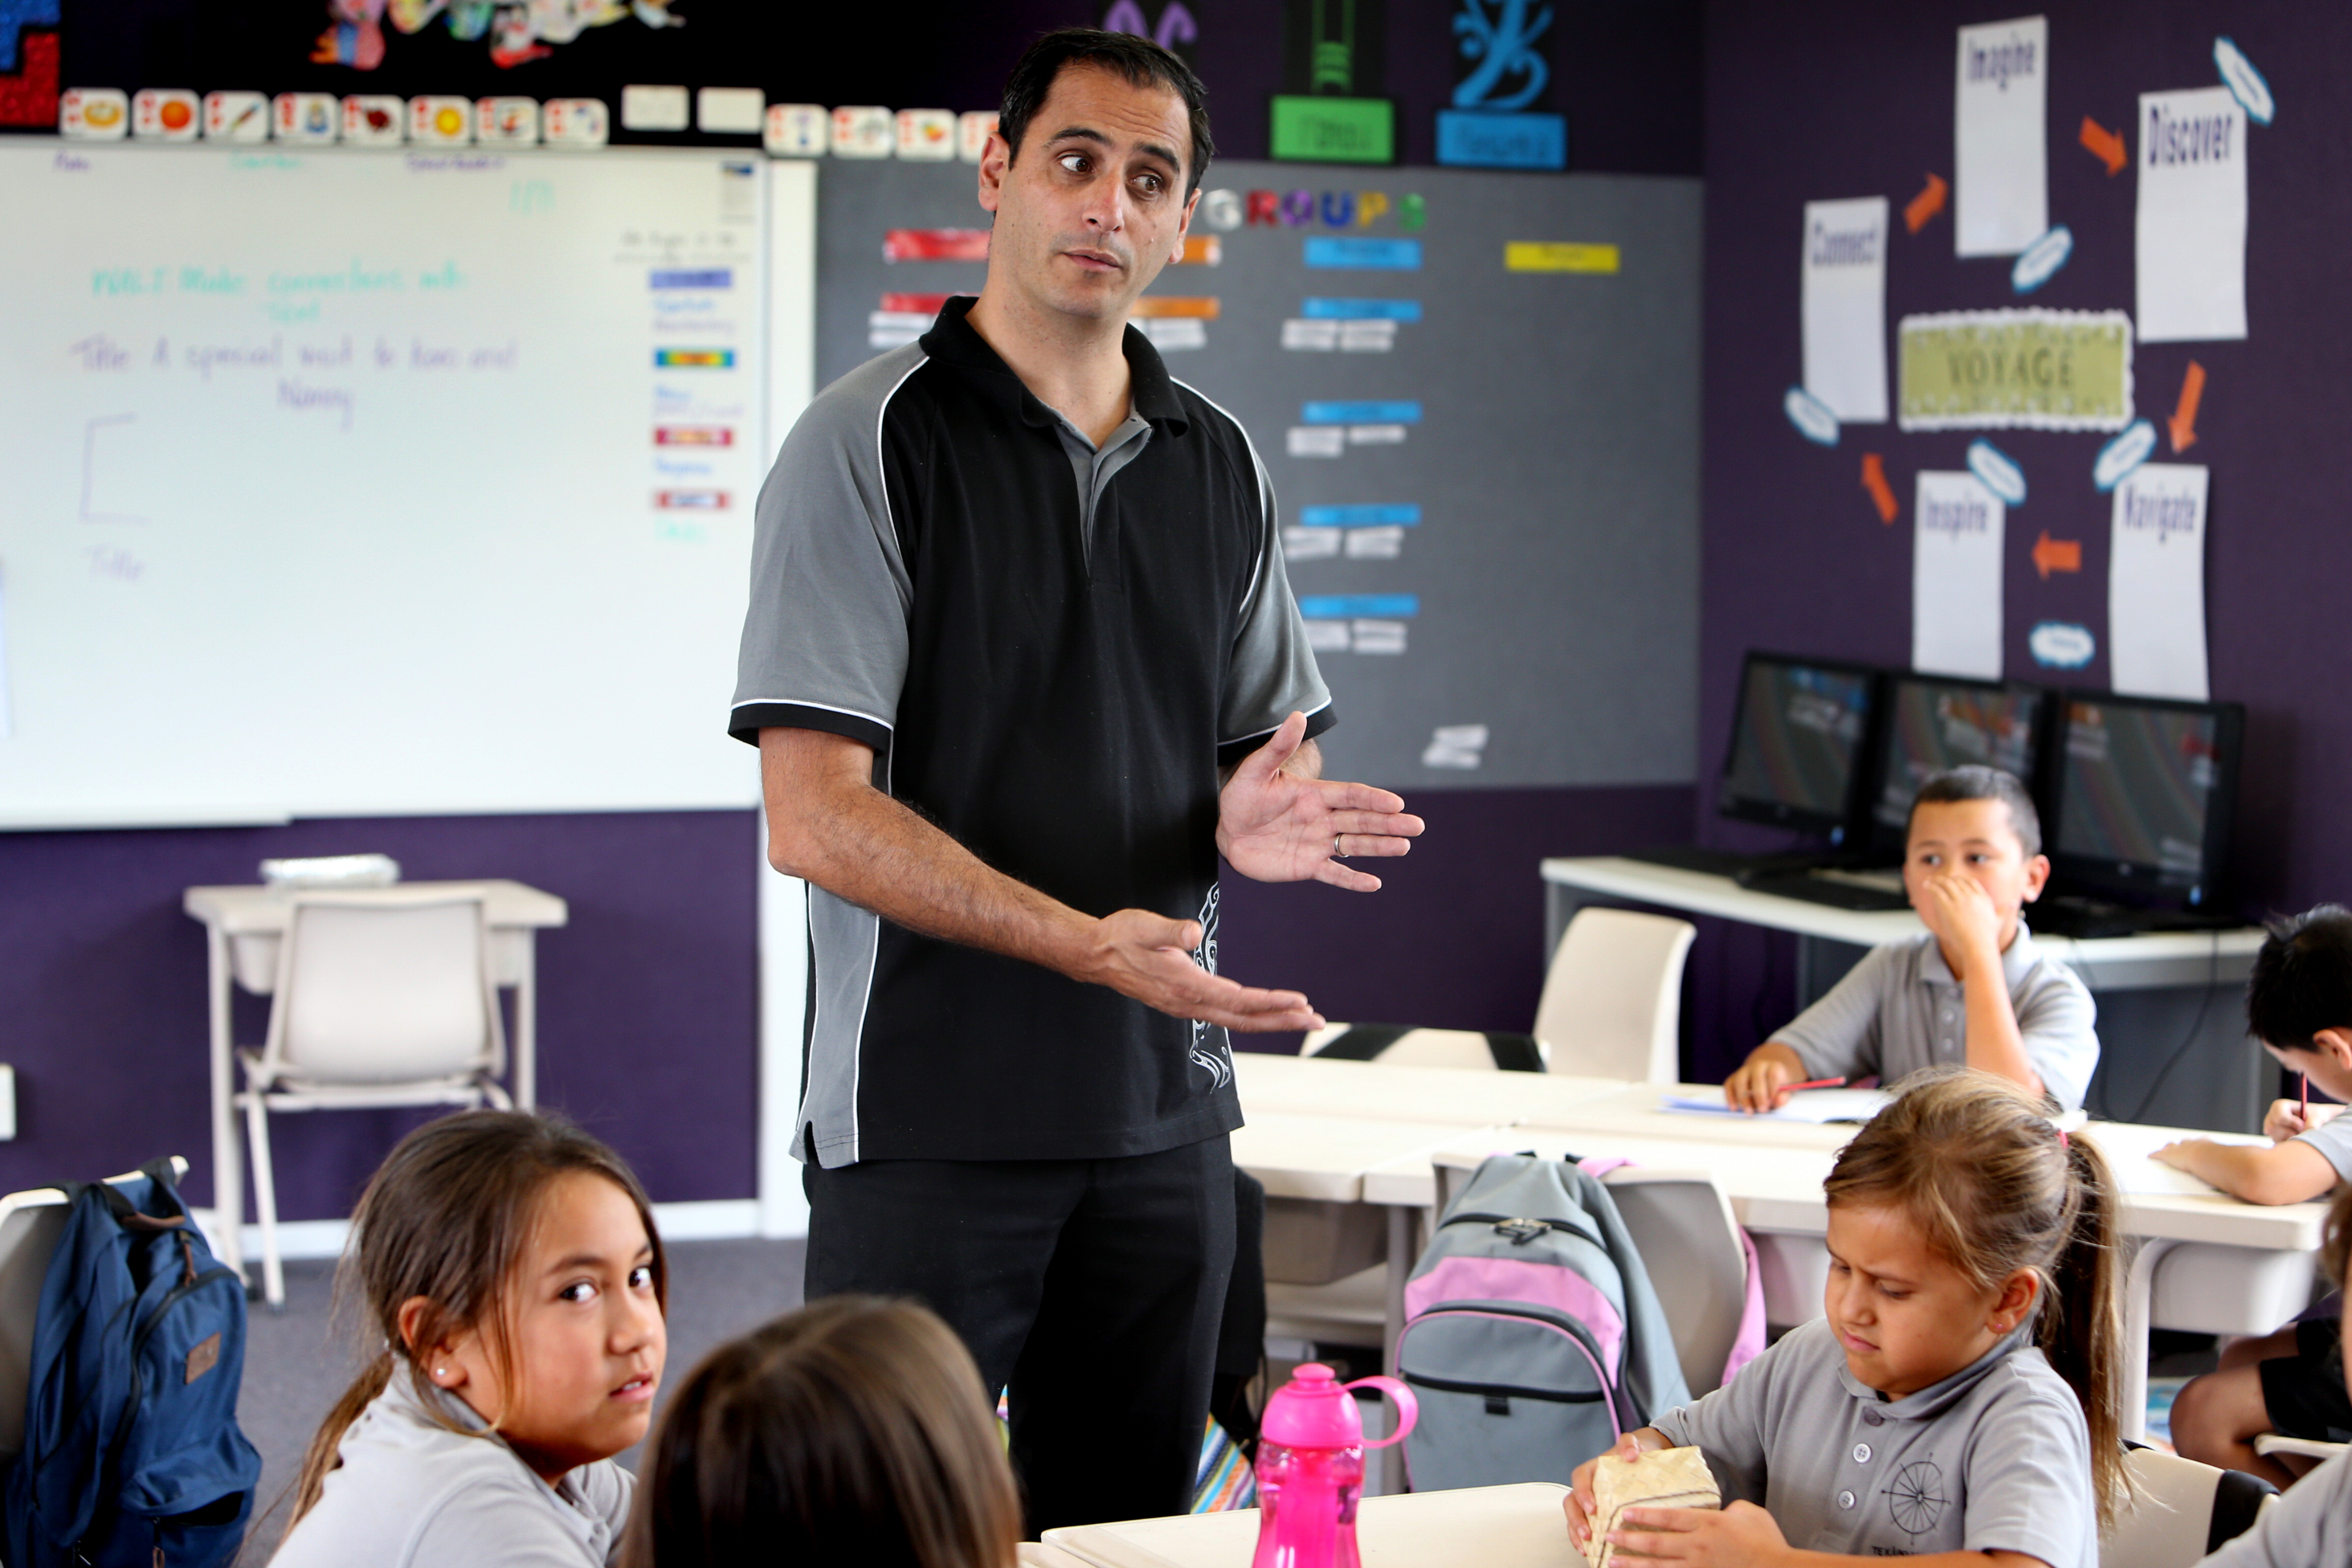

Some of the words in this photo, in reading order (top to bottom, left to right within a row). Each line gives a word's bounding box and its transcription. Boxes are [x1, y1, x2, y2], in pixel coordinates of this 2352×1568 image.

[1967, 32, 2035, 91] Imagine
[2149, 105, 2234, 166] Discover
[1203, 189, 1426, 231] GROUPS
[1811, 220, 1879, 266] Connect
[1947, 348, 2074, 387] VOYAGE
[1923, 492, 1989, 541] Inspire
[2123, 483, 2196, 544] Navigate
